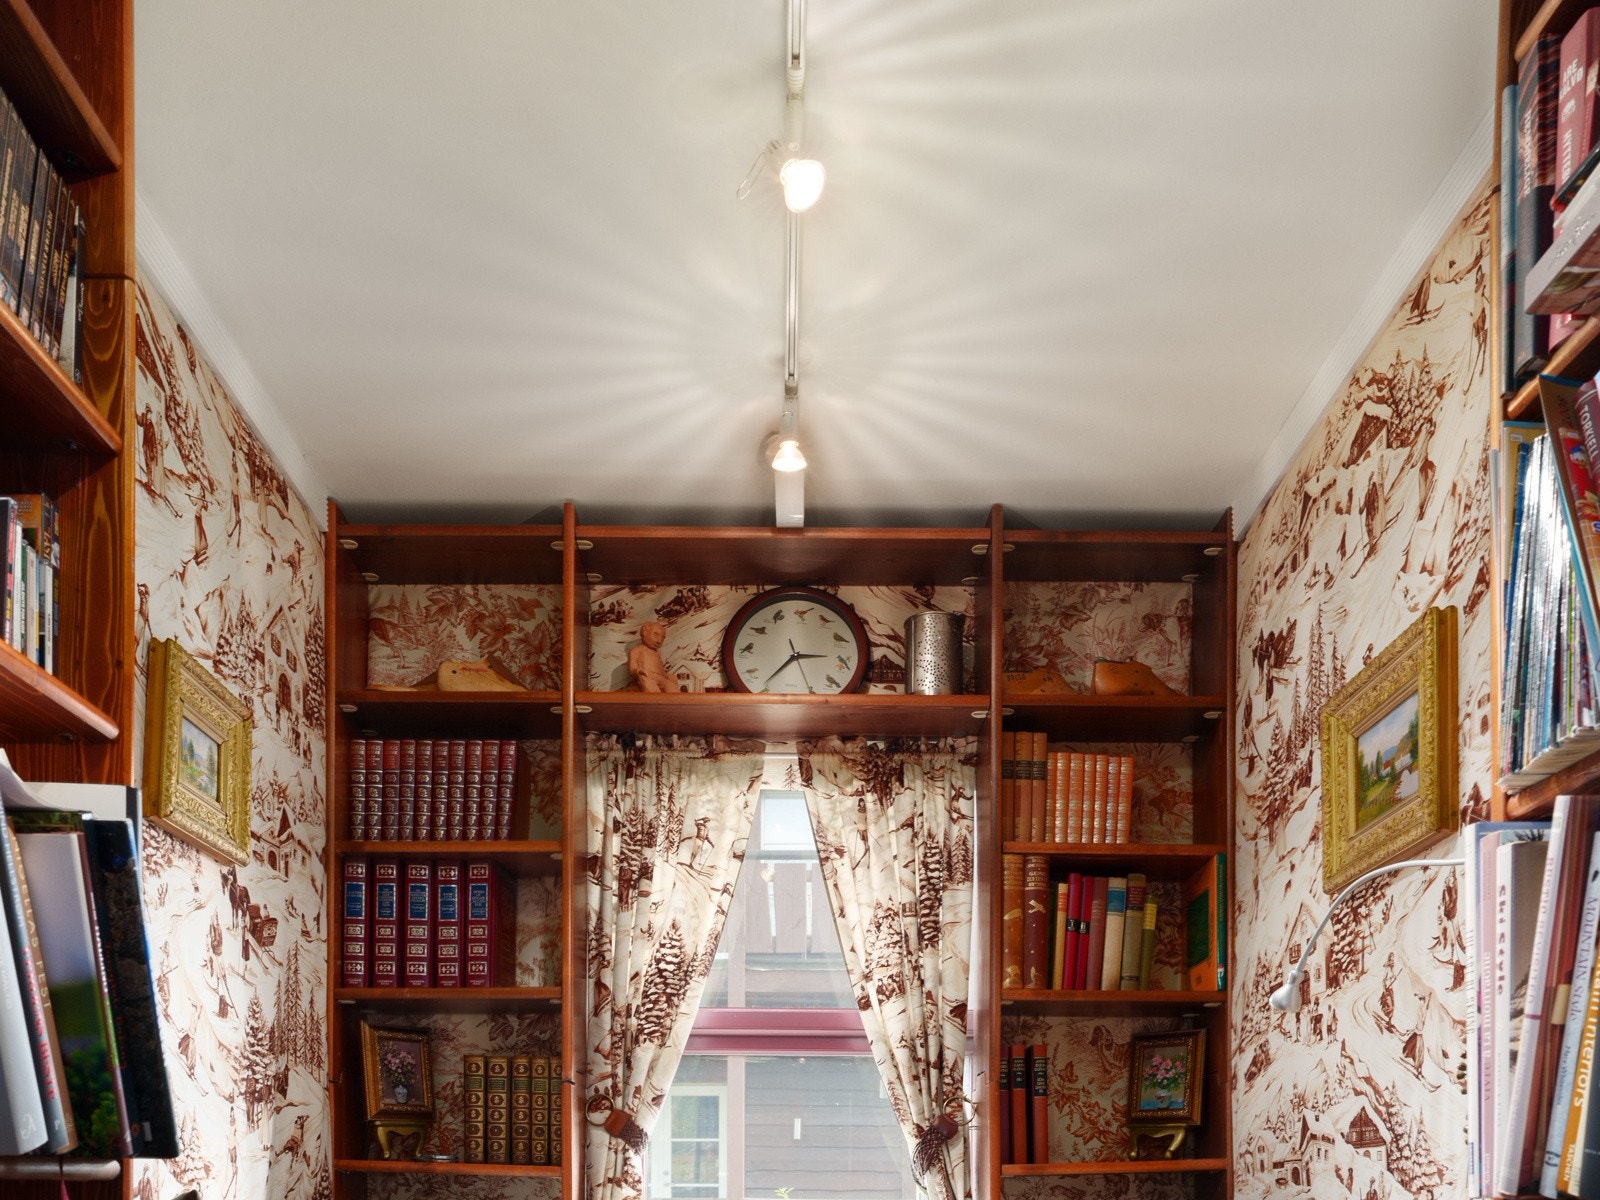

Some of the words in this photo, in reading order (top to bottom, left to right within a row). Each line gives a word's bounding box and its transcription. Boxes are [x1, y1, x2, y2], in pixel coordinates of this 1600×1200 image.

[1498, 884, 1506, 924] Ski
[1540, 857, 1555, 914] RUSTIC
[13, 836, 39, 948] NIGELLAS
[35, 960, 52, 1008] FEST
[1575, 896, 1599, 983] MOUNTAIN
[1497, 932, 1506, 996] Style
[1569, 984, 1583, 1021] Style
[1573, 1017, 1599, 1108] interiors
[1563, 1143, 1576, 1182] TASCHEN
